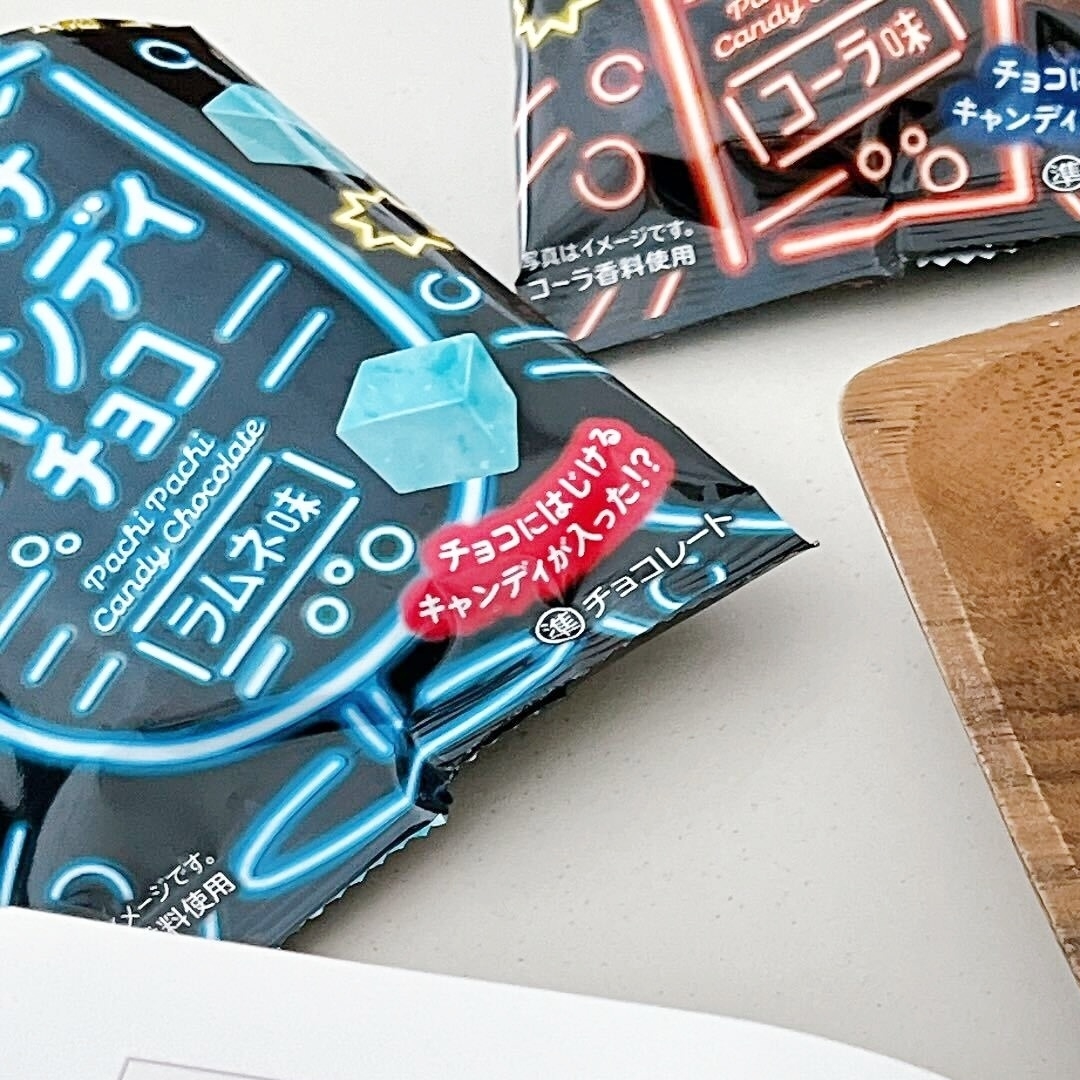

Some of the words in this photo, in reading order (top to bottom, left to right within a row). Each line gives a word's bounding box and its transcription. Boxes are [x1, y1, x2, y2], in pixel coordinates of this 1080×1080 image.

[714, 2, 804, 58] Candy
[759, 8, 931, 136] コーラ味
[527, 244, 697, 301] コーラ香料使用
[33, 325, 218, 506] チョコ
[84, 510, 155, 591] Pachi
[146, 431, 216, 512] Pachi
[168, 488, 322, 644] ラムネ味
[438, 427, 622, 573] チョコにはじける
[93, 545, 171, 632] Candy
